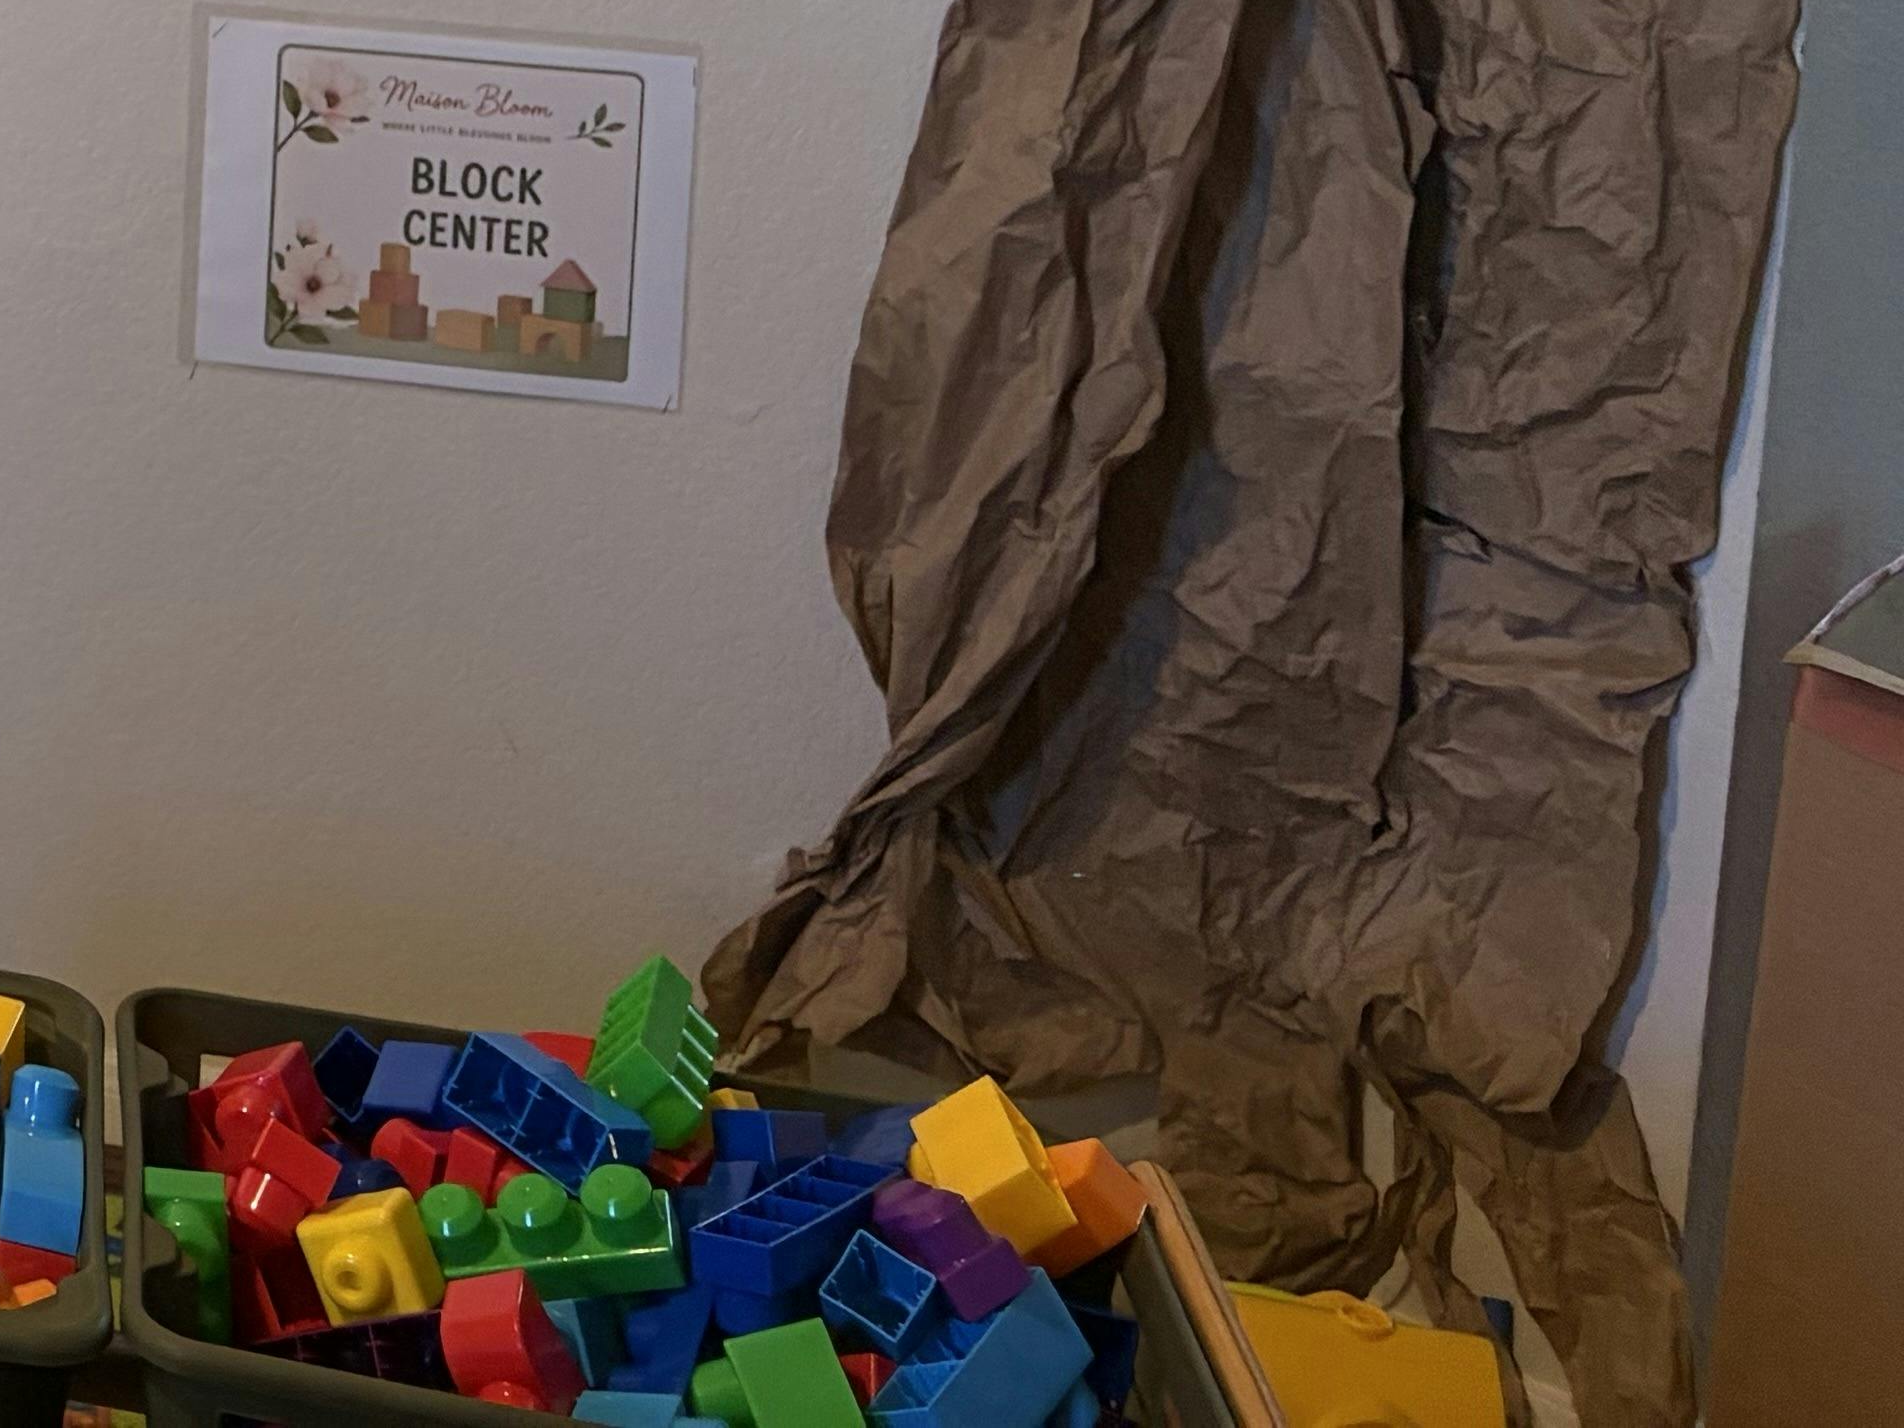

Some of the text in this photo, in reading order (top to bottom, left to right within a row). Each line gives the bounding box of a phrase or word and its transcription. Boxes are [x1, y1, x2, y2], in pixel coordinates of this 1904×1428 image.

[379, 75, 553, 118] Maison Bloom
[411, 157, 543, 206] BLOCK
[403, 209, 549, 258] CENTER
